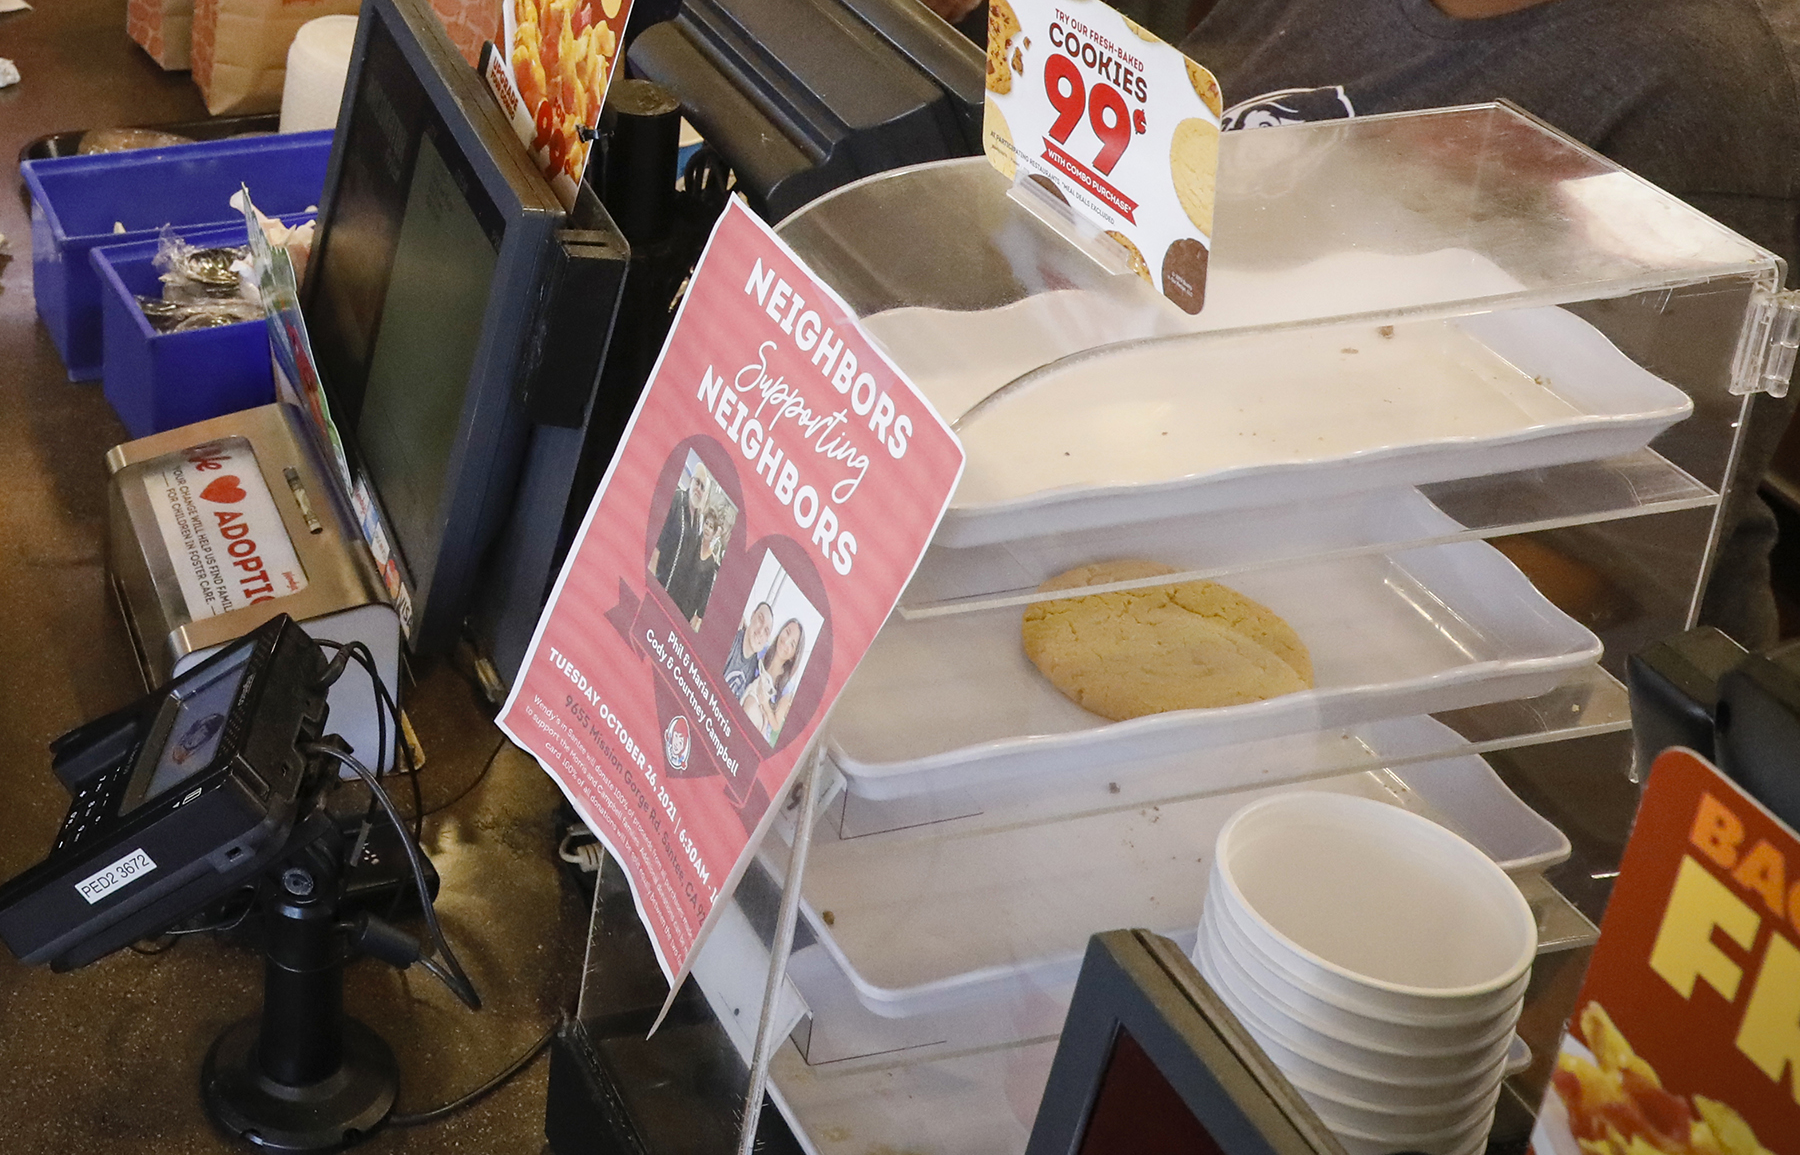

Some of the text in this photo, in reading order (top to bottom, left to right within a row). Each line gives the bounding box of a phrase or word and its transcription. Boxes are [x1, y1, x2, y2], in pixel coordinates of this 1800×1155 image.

[1050, 23, 1147, 101] COOKIES
[1055, 8, 1143, 72] TRY OUR FRESH-BAKED
[1048, 149, 1064, 166] WITH
[1066, 162, 1090, 185] COMBO
[1076, 192, 1089, 206] DEALS
[744, 256, 913, 460] NEIGHBORS
[734, 340, 870, 504] Supporting
[172, 465, 185, 484] YOUR
[180, 486, 196, 515] CHANGE
[696, 364, 858, 576] NEIGHBORS
[166, 488, 213, 604] FOR CHILDREN IN FOSTER CARE.
[191, 515, 203, 534] WILL
[198, 534, 210, 552] HELP
[204, 553, 215, 565] US
[209, 565, 222, 585] FIND
[646, 629, 738, 775] Cody & Courtney Campbell
[668, 631, 731, 737] Phil & Maria Morris
[534, 695, 560, 724] Wendy's
[560, 723, 567, 732] in
[567, 728, 586, 754] Santee
[586, 752, 596, 766] will
[595, 765, 614, 790] donate
[613, 787, 627, 810] 100%
[627, 809, 634, 818] of
[632, 817, 652, 851] proceeds
[652, 849, 662, 870] from
[550, 647, 599, 705] TUESDAY
[600, 705, 645, 767] OCTOBER
[645, 765, 656, 790] 26,
[657, 786, 676, 821] 2021
[679, 830, 709, 884] 6:30AM
[565, 695, 590, 728] 9655
[589, 726, 623, 772] Mission
[624, 770, 649, 812] Gorge
[649, 808, 661, 835] Rd.
[661, 831, 683, 886] Santee,
[685, 882, 697, 909] CA
[525, 705, 533, 716] to
[533, 714, 559, 740] support
[560, 738, 570, 752] the
[569, 750, 587, 774] Morris
[586, 773, 598, 787] and
[597, 785, 622, 819] Campbell
[639, 848, 658, 884] Additional
[656, 884, 674, 921] donations
[673, 921, 681, 936] can
[562, 758, 577, 779] 100%
[577, 778, 584, 787] of
[583, 786, 591, 796] all
[590, 795, 616, 830] donations
[617, 829, 626, 843] will
[624, 840, 631, 853] be
[639, 868, 650, 893] equally
[649, 893, 666, 927] between
[670, 940, 678, 956] two
[81, 854, 150, 898] PED2 3672
